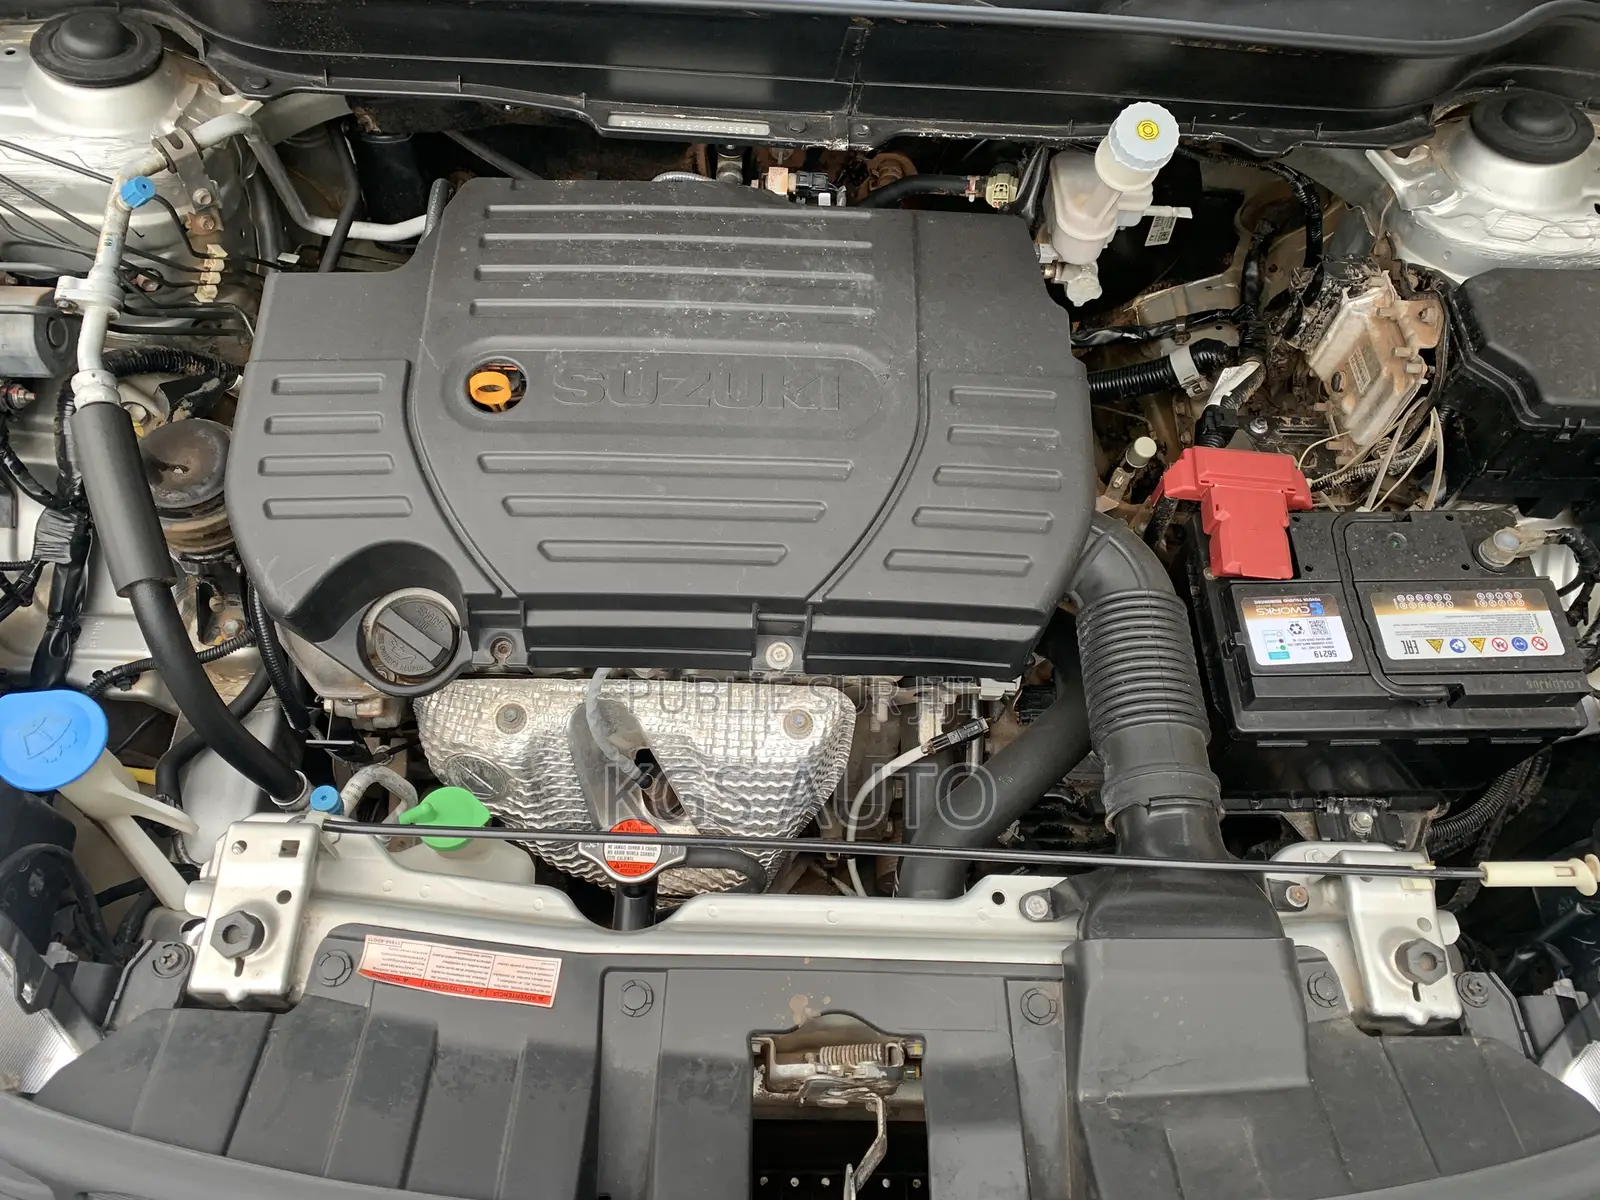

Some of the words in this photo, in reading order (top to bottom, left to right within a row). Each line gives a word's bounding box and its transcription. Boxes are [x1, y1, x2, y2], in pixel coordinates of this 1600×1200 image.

[552, 367, 840, 411] SUZUKI
[418, 606, 447, 630] ENGINE
[1313, 649, 1337, 659] 56219
[493, 991, 537, 1000] ADVERTENCIA
